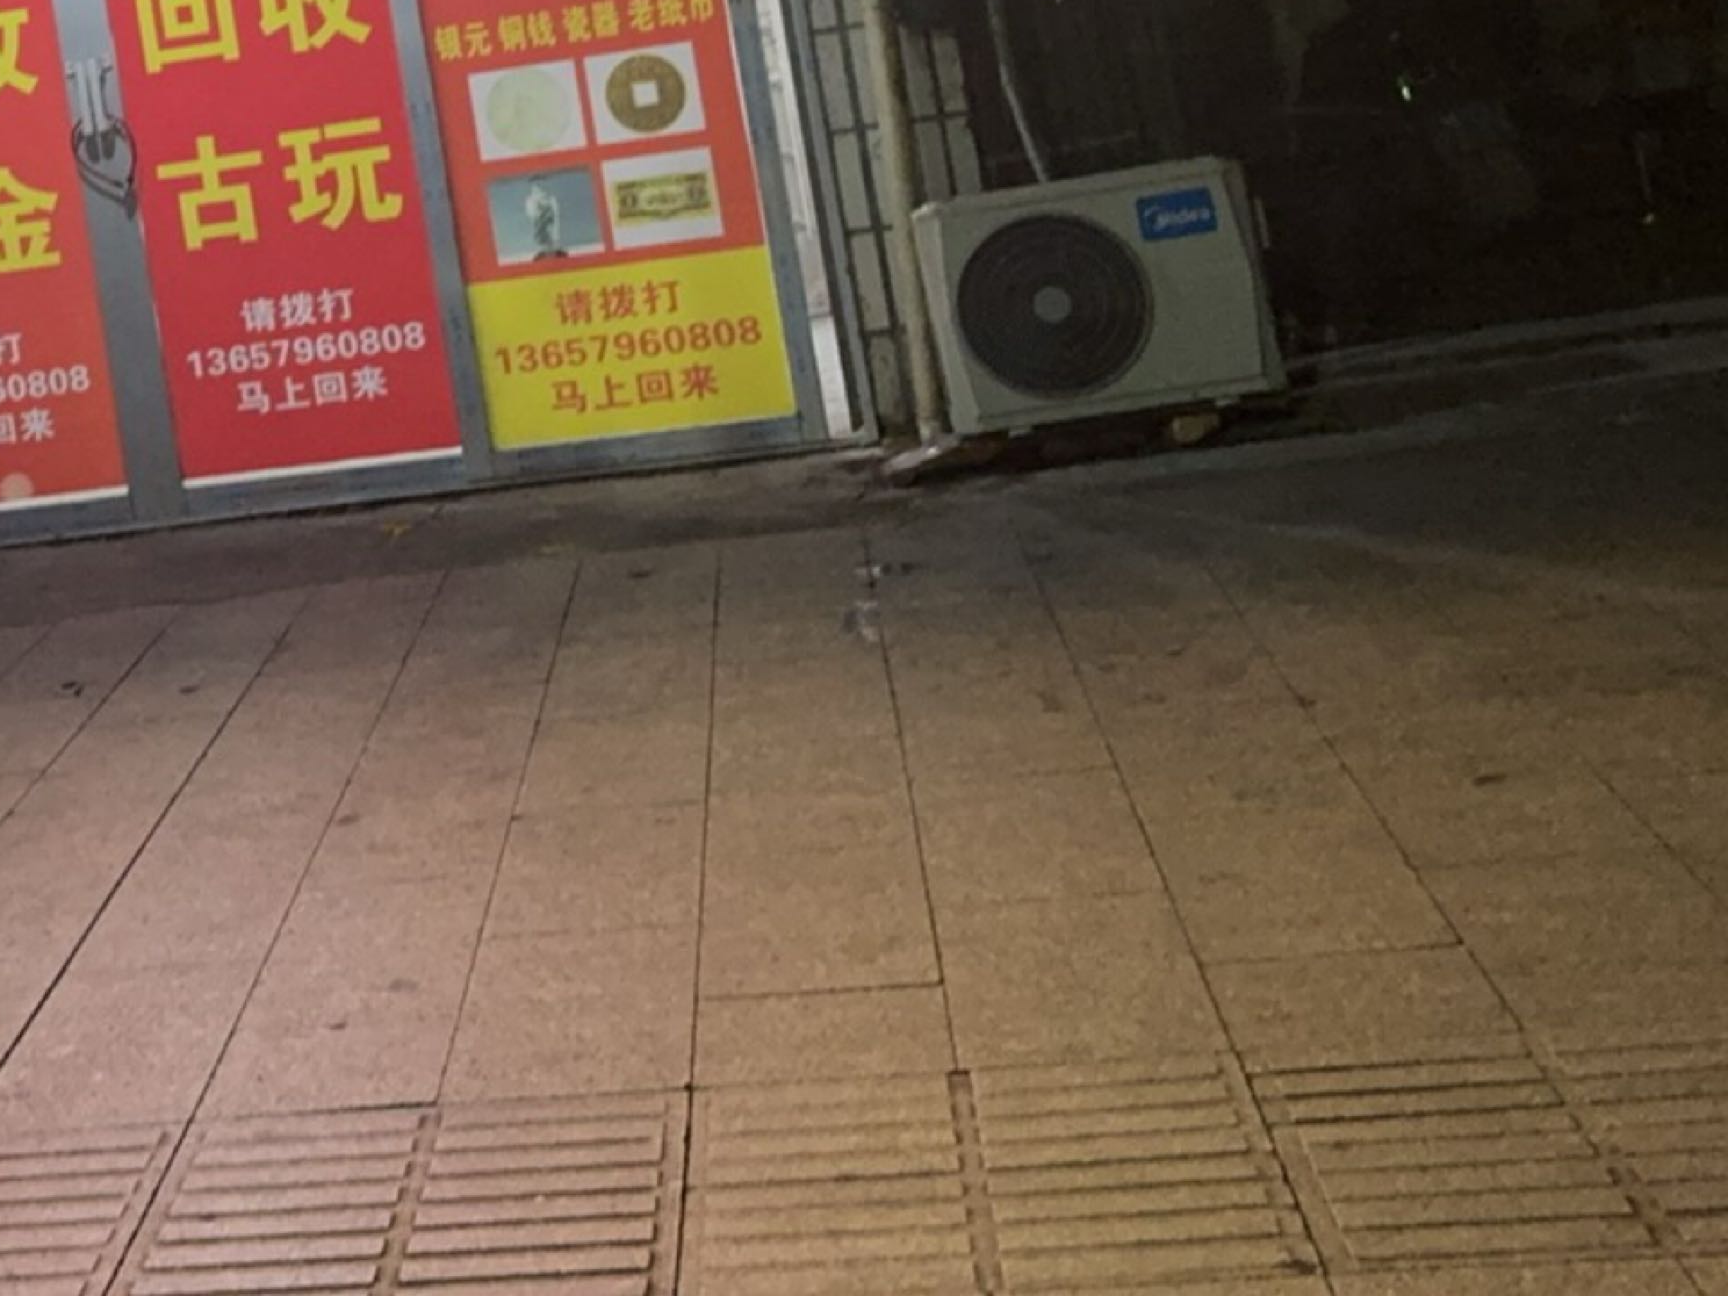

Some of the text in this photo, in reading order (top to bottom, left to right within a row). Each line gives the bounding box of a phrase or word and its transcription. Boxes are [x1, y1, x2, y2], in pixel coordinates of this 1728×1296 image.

[157, 117, 403, 251] 古玩
[240, 287, 354, 334] 请拨打
[554, 279, 682, 326] 请拨打
[186, 321, 426, 379] 13657960808
[494, 315, 763, 376] 13657960808
[237, 367, 389, 416] 马上回来
[551, 363, 721, 414] 马上回来
